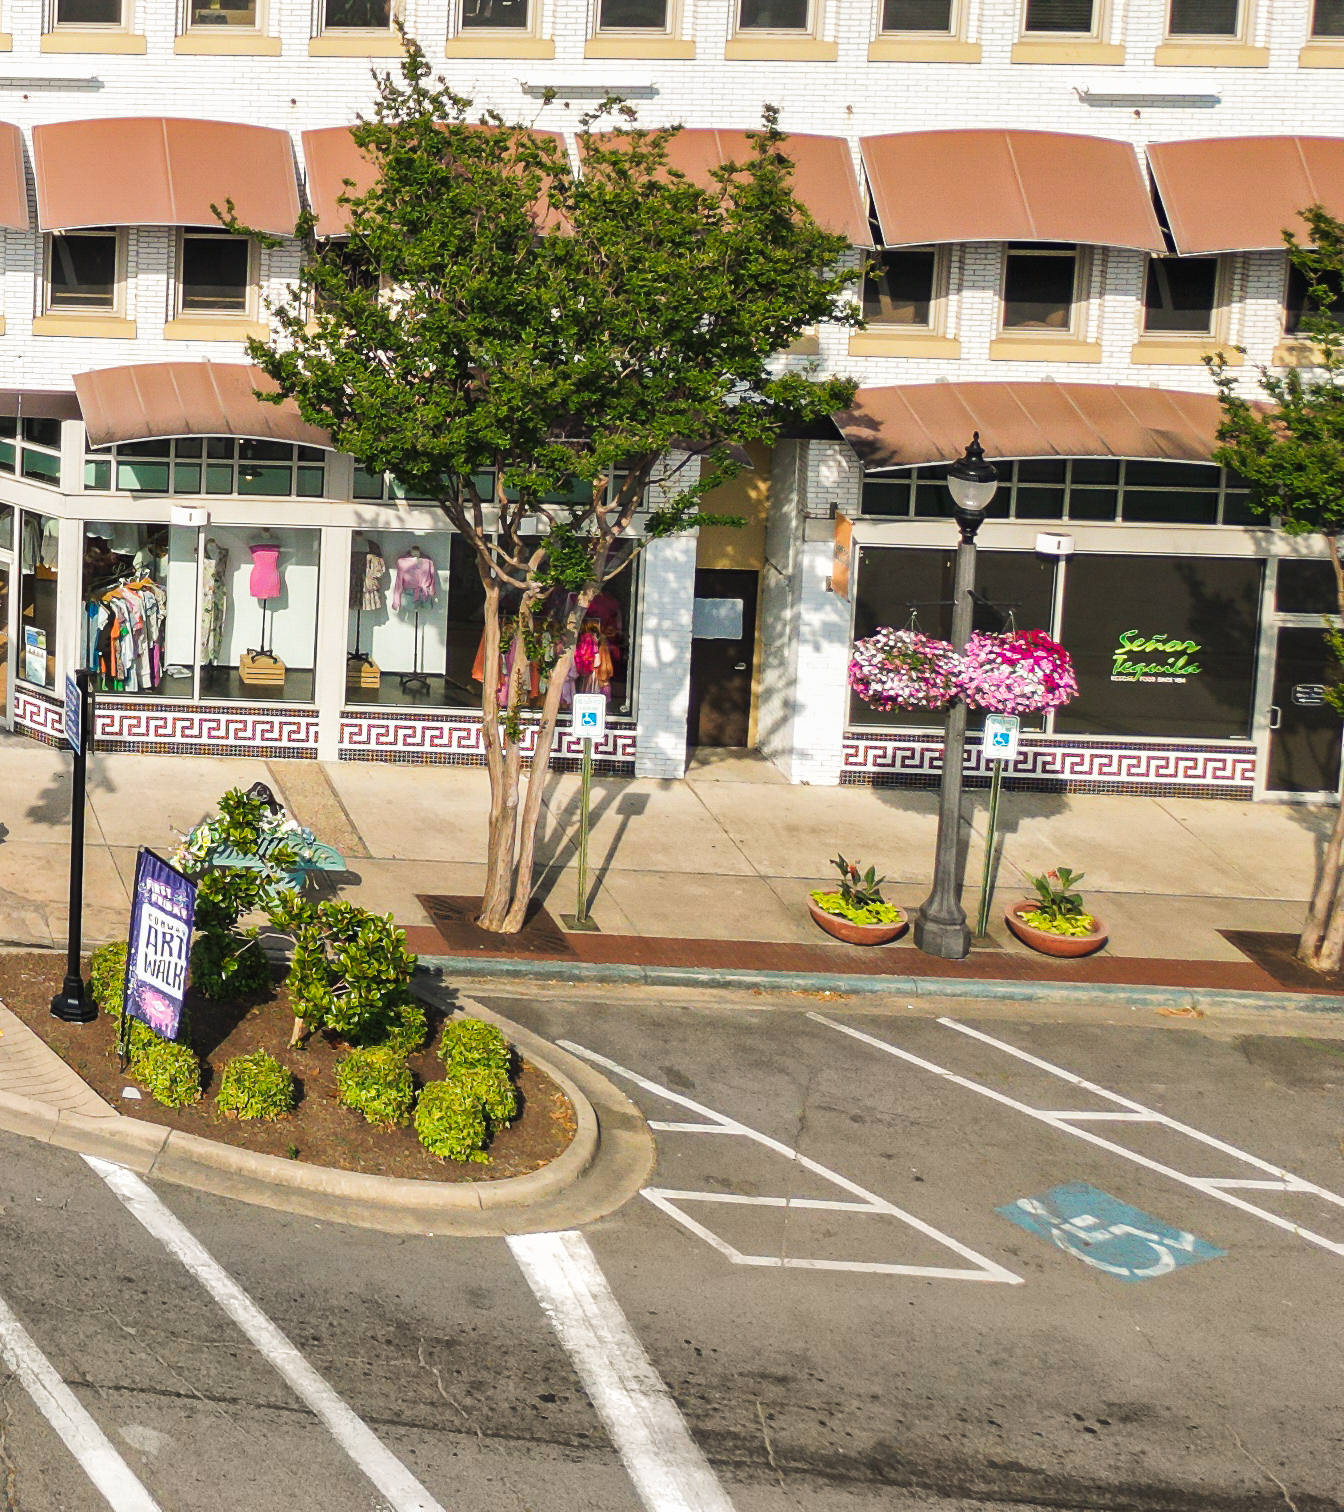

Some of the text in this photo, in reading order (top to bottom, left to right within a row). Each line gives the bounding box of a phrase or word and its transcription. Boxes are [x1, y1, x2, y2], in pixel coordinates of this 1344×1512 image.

[1115, 629, 1202, 654] Señor
[1112, 654, 1203, 681] Tequila
[146, 877, 172, 898] FIRST
[151, 892, 188, 920] FRIDAY
[148, 912, 187, 936] CONWAY
[145, 924, 186, 961] ART
[144, 954, 184, 991] WALK
